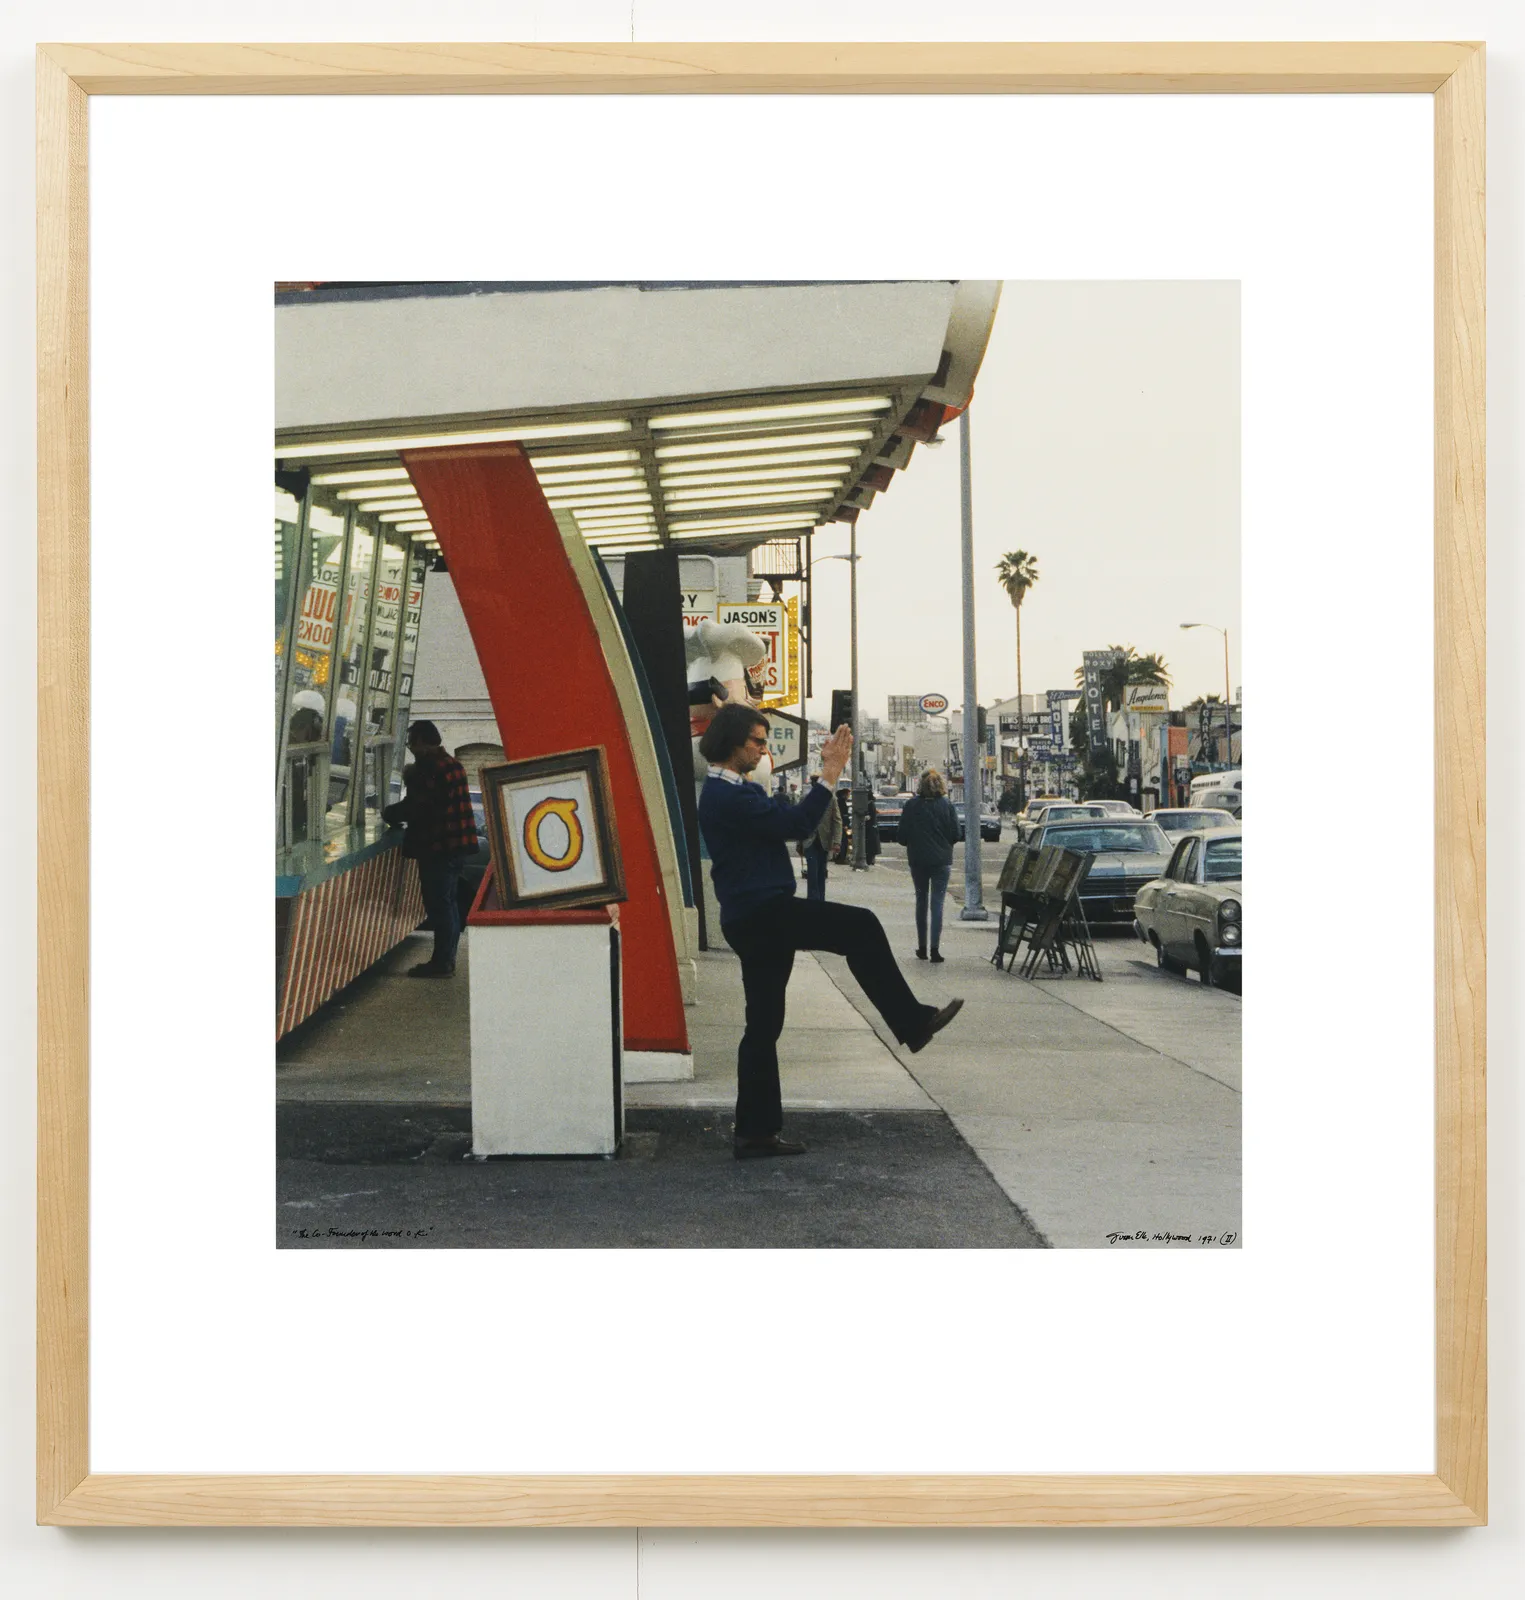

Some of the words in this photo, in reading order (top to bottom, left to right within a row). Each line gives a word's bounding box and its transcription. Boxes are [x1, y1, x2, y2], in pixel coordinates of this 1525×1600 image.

[723, 610, 777, 624] JASON'S
[923, 699, 945, 708] ENCO
[1087, 672, 1103, 747] HOTEL
[381, 1230, 402, 1238] word
